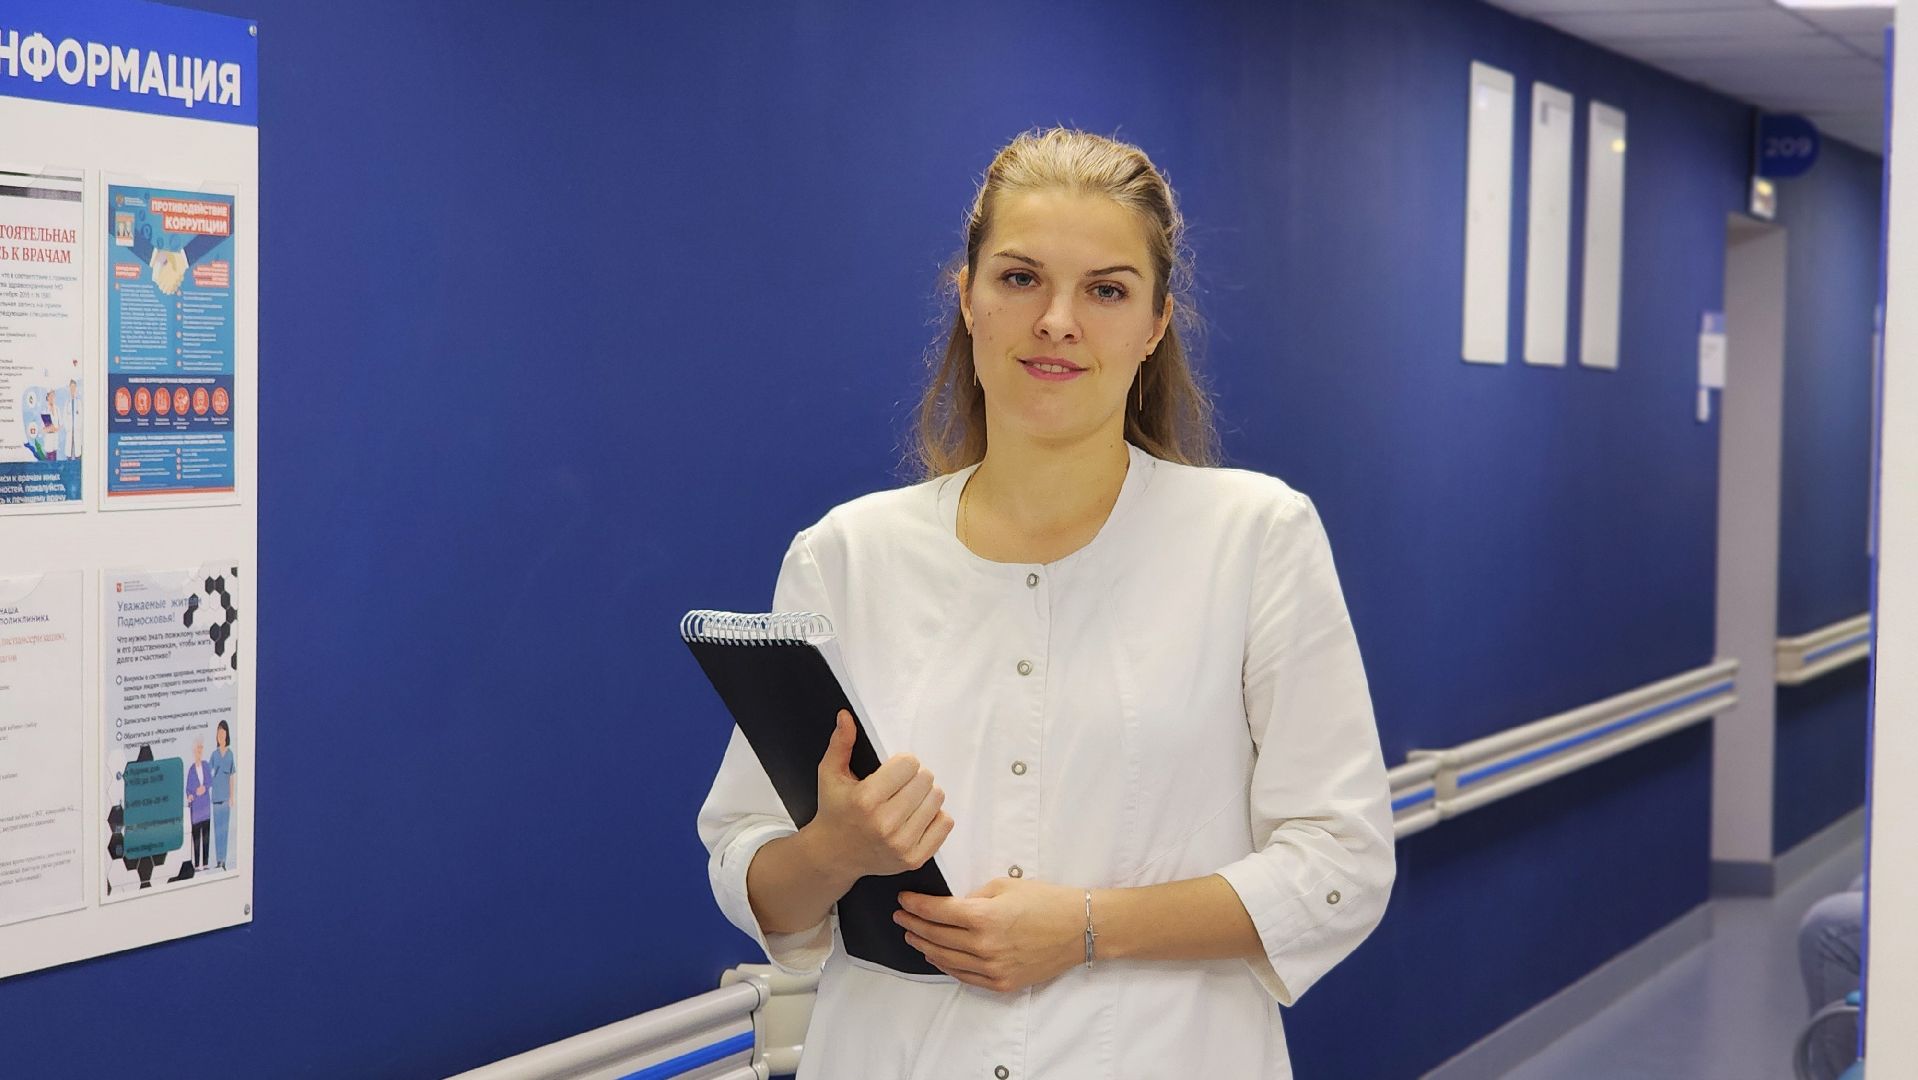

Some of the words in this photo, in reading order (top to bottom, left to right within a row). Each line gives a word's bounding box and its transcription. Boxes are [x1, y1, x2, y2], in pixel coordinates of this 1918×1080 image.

[1765, 137, 1812, 158] 209
[152, 201, 228, 217] ПРОТИВОДЕЙСТВИЕ
[165, 217, 228, 234] КОРРУПЦИИ
[12, 247, 19, 261] К
[23, 248, 72, 264] ВРАЧАМ
[117, 599, 166, 612] Уважаемые
[117, 613, 175, 628] Подмосковья!
